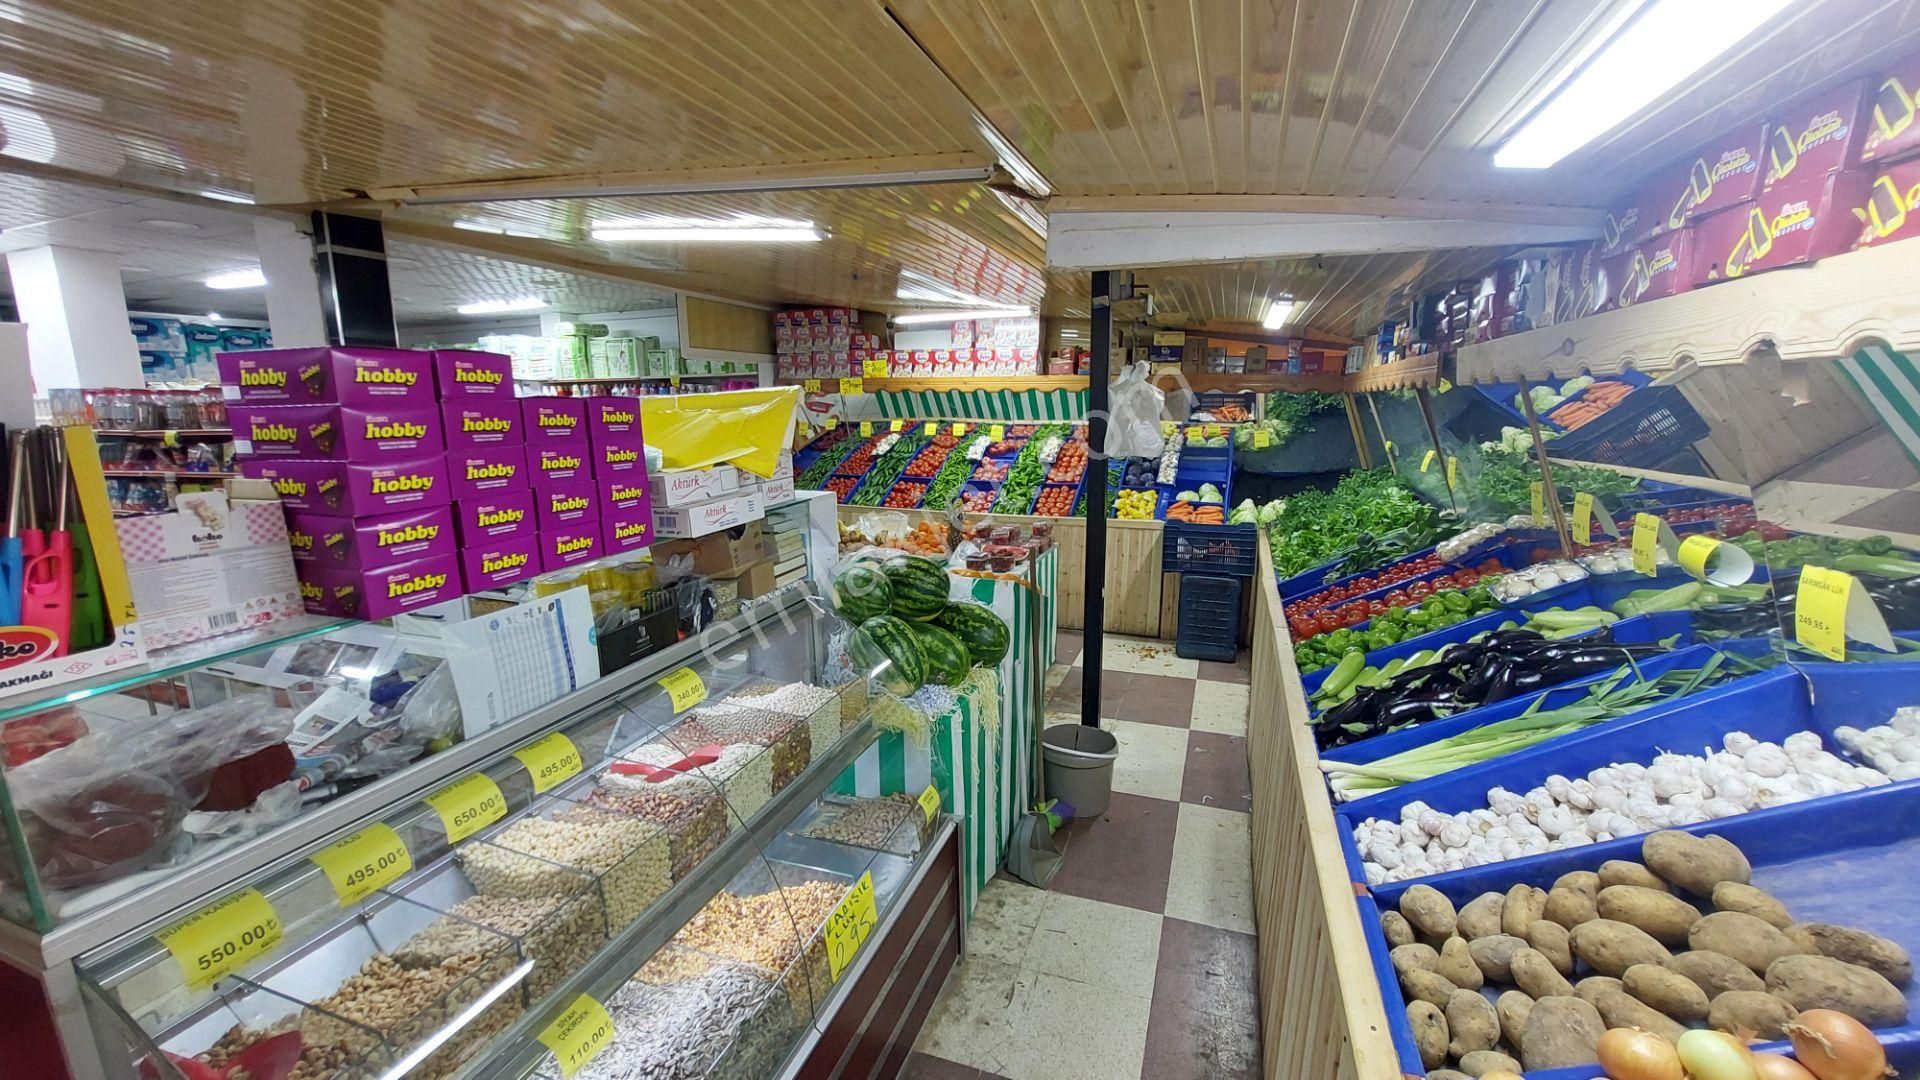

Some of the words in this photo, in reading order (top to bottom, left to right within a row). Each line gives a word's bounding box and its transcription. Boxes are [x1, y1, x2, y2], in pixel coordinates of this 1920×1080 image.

[241, 368, 287, 387] hobby
[356, 367, 417, 386] hobby
[456, 368, 502, 385] hobby
[463, 417, 511, 432] hobby
[539, 415, 577, 428] hobby
[603, 410, 634, 424] hobby
[252, 424, 297, 443] hobby
[366, 422, 426, 439] hobby
[541, 457, 581, 470] hobby
[607, 451, 638, 463] hobby
[467, 463, 515, 480] hobby
[372, 475, 433, 494] hobby
[671, 474, 700, 491] Aktürk
[612, 488, 642, 501] hobby
[552, 496, 588, 513] hobby
[704, 504, 728, 519] Aktürk
[479, 508, 524, 527] hobby
[379, 524, 439, 547] hobby
[616, 525, 646, 539] hobby
[556, 536, 593, 555] hobby
[482, 552, 528, 574] hobby
[388, 573, 447, 598] hobby
[0, 670, 54, 690] AKMAĞI
